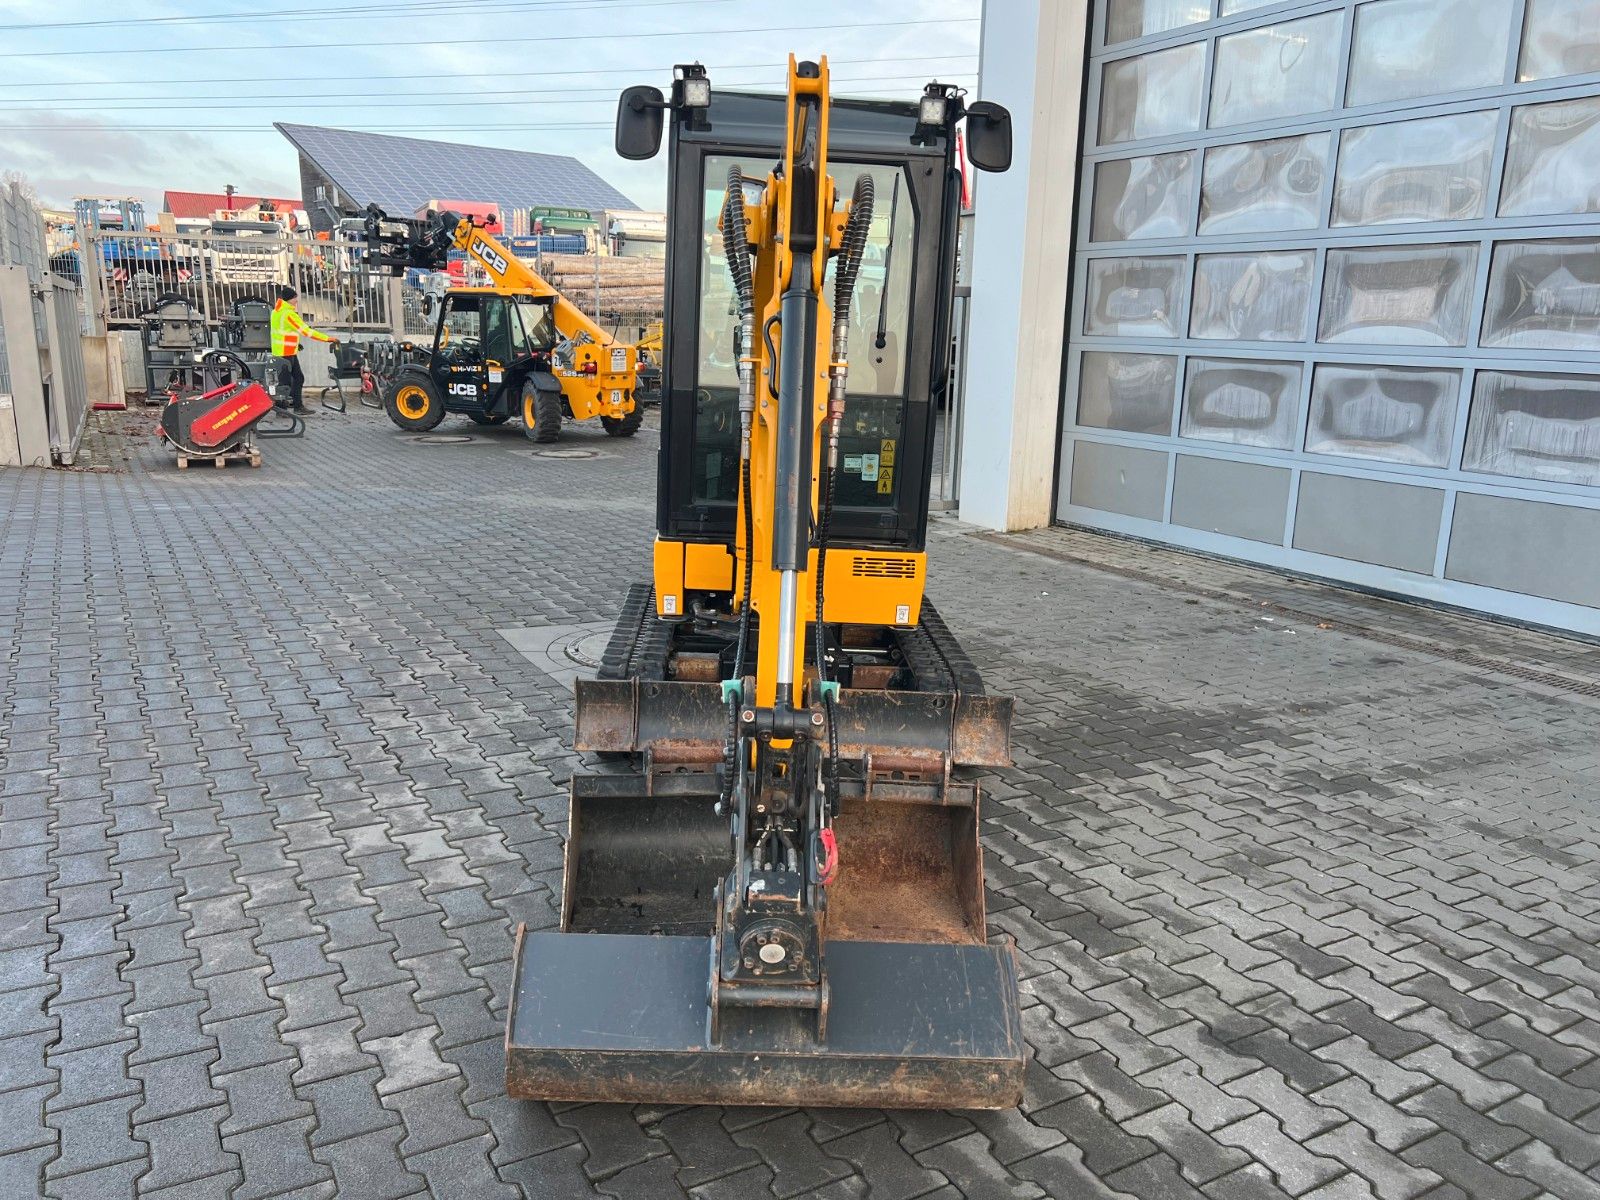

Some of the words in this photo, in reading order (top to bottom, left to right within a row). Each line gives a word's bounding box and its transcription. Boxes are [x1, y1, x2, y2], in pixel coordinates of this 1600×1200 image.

[472, 238, 508, 274] JCB
[612, 348, 626, 356] JCB
[448, 383, 477, 396] JCB
[613, 392, 620, 402] 20
